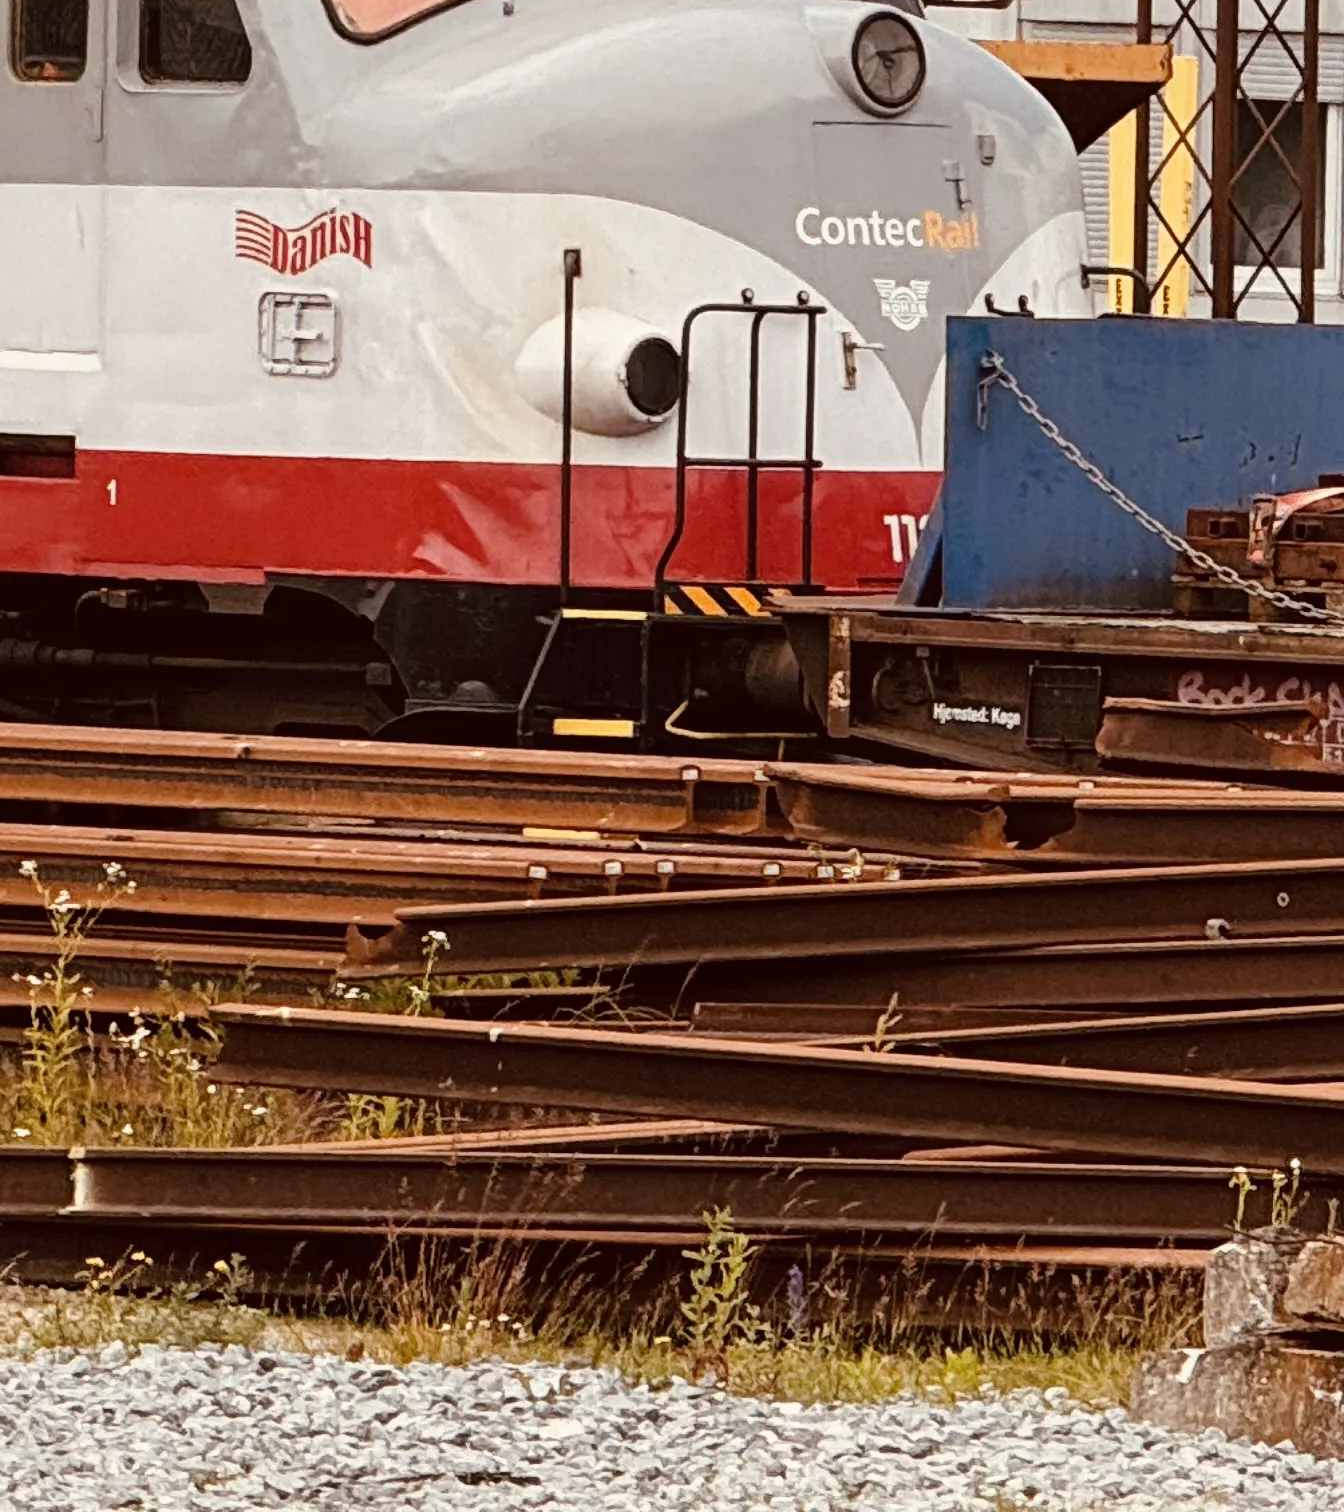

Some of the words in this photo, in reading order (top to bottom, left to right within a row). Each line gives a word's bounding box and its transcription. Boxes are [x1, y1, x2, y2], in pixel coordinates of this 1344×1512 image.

[795, 207, 980, 257] ContecRail
[107, 478, 117, 506] 1
[883, 514, 929, 563] 11
